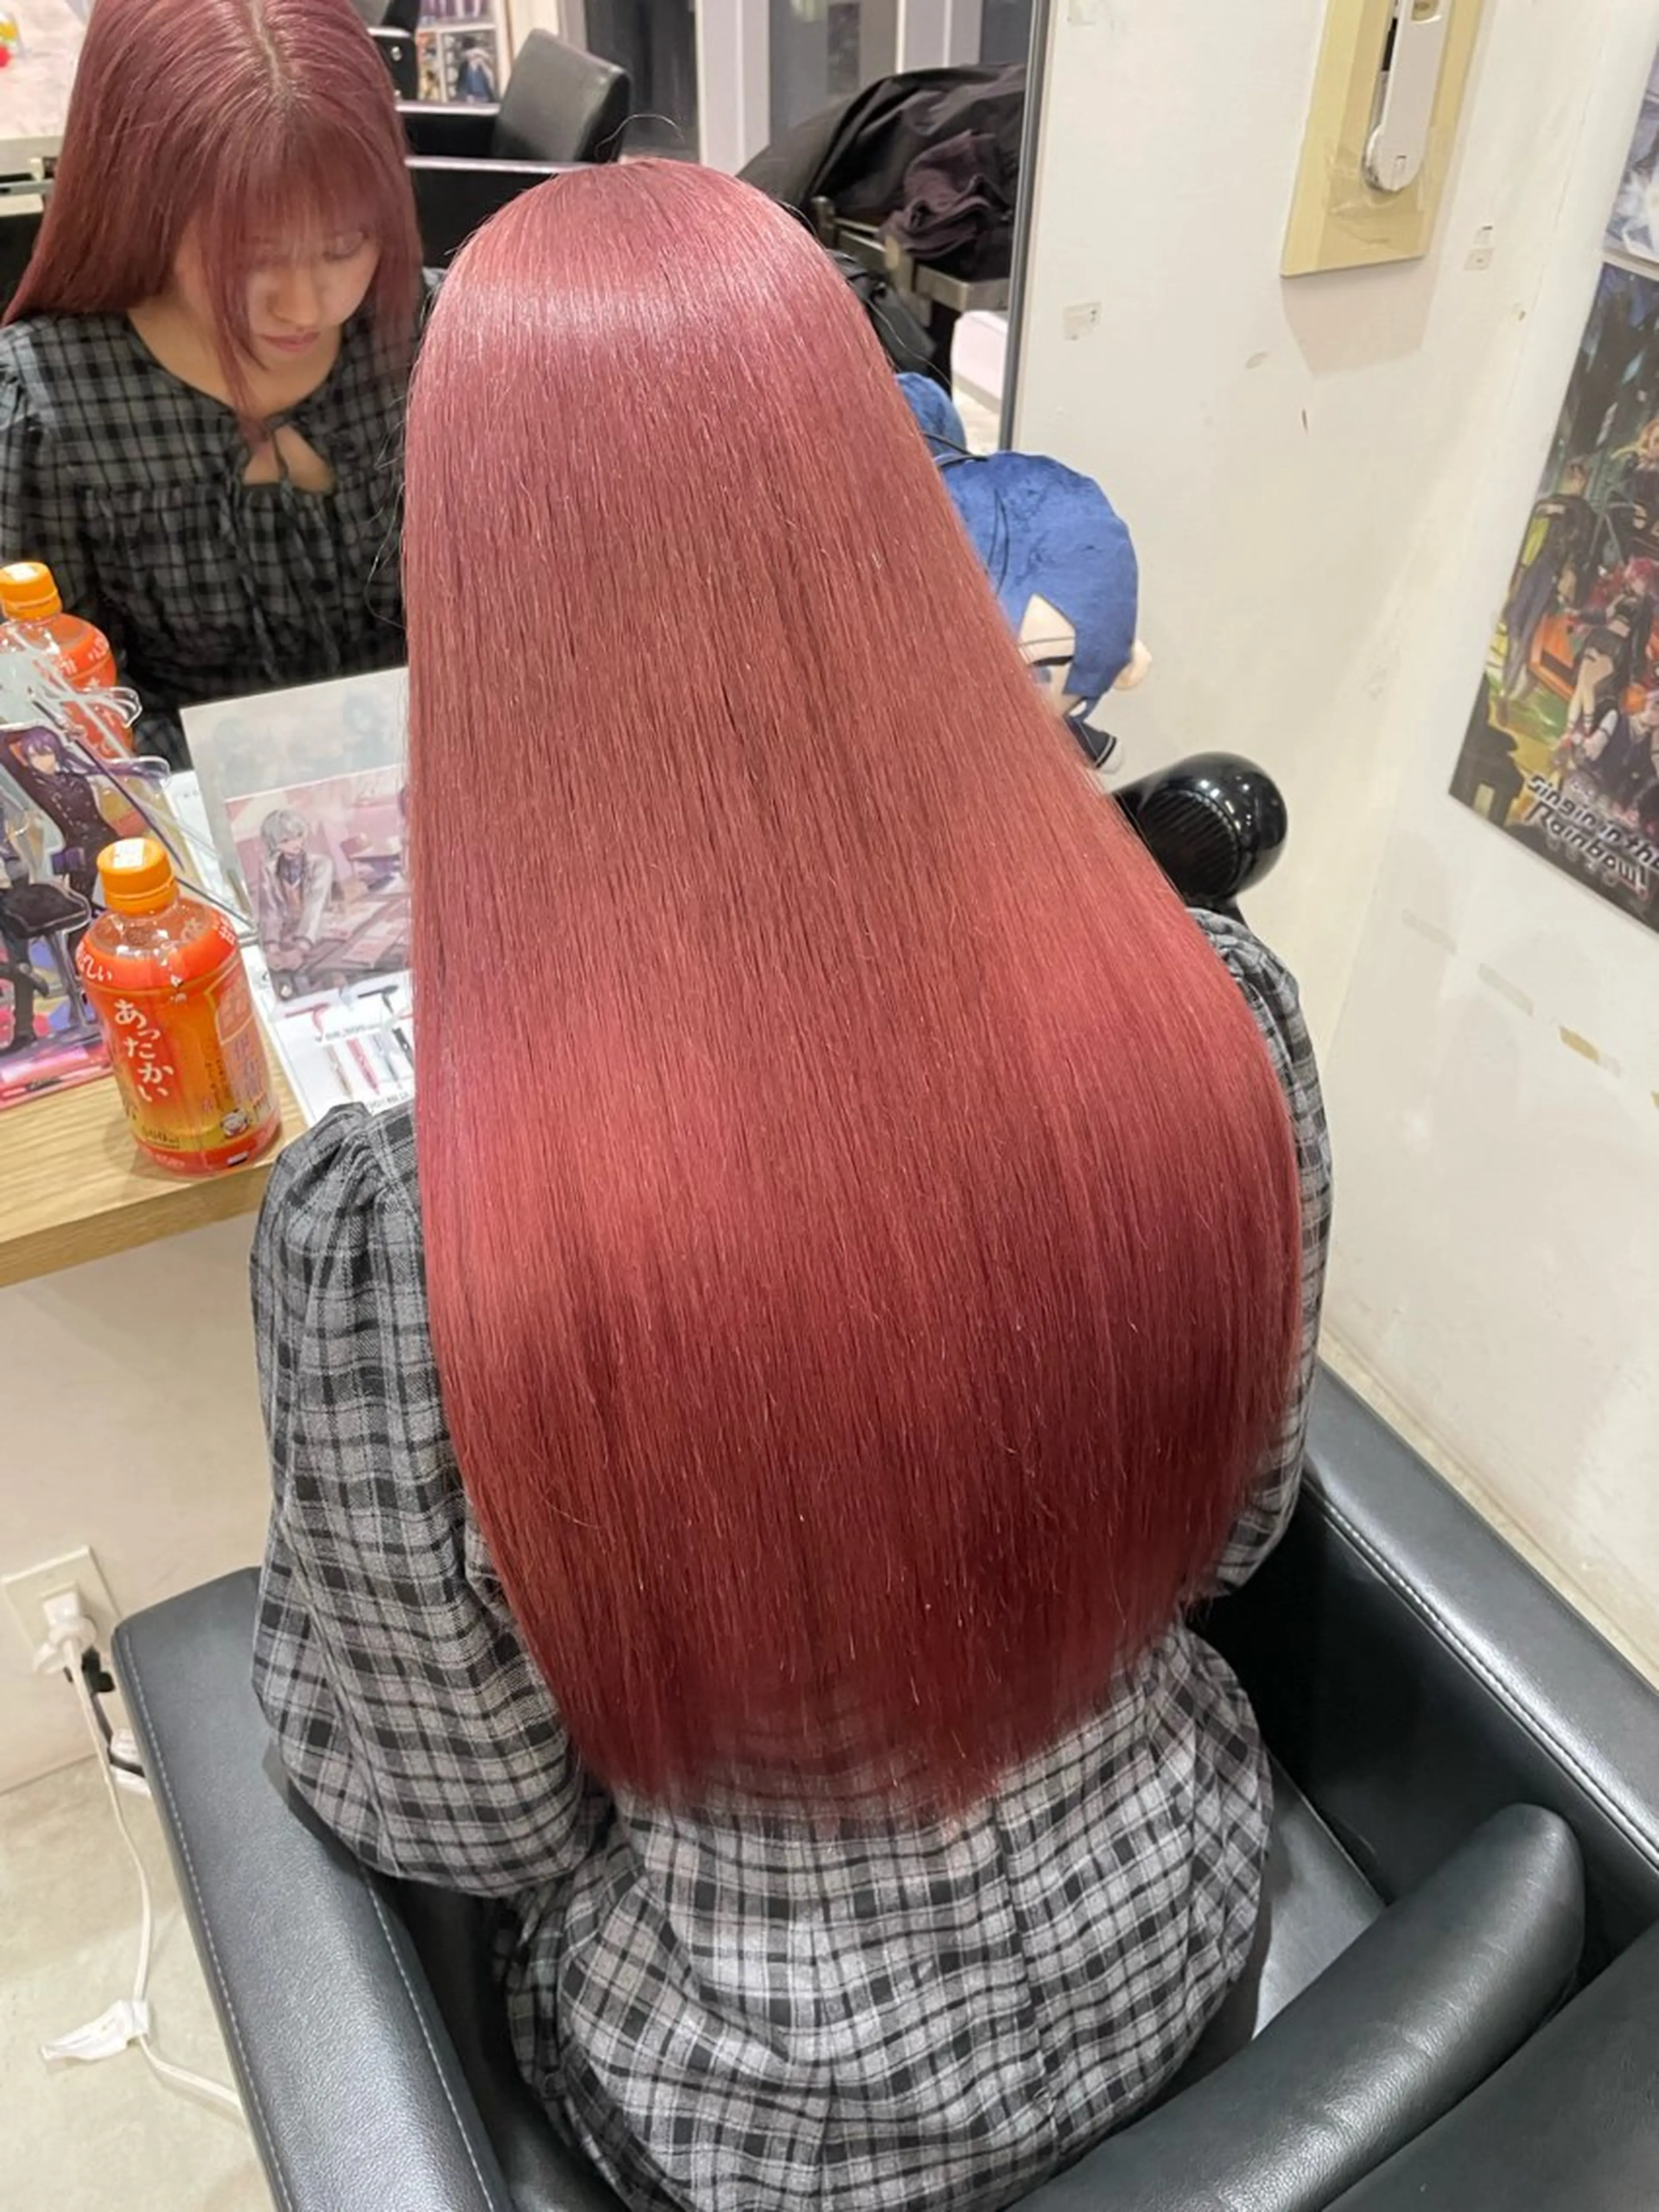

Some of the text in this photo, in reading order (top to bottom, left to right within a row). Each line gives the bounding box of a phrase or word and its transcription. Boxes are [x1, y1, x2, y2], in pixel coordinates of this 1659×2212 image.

[114, 998, 174, 1102] あったかい
